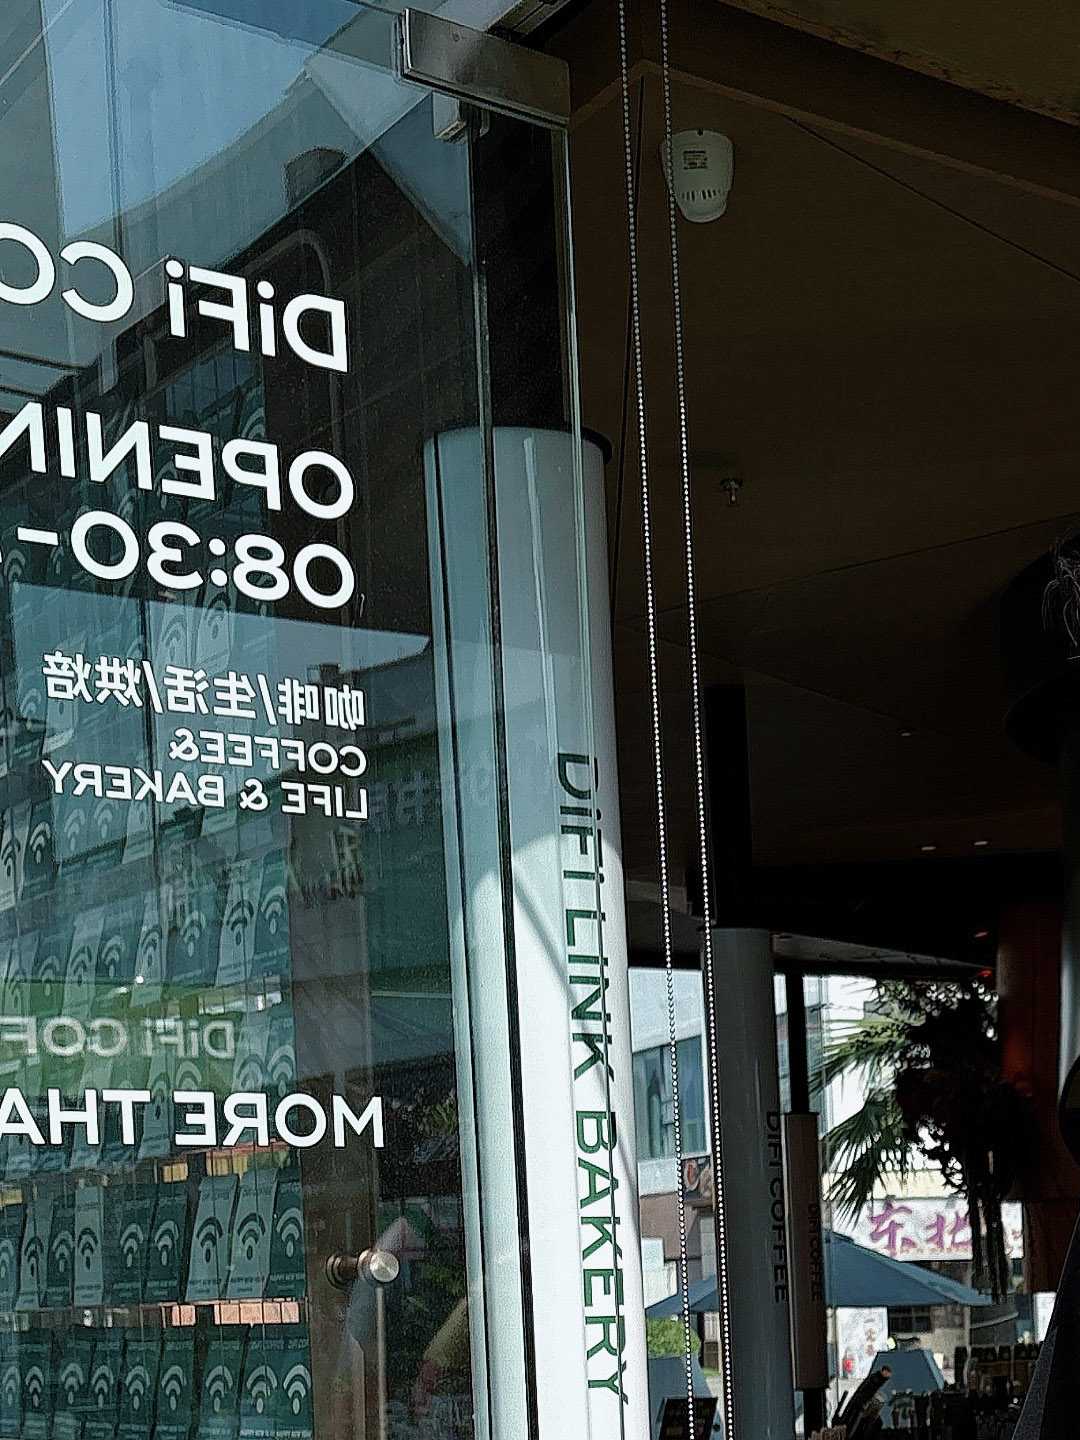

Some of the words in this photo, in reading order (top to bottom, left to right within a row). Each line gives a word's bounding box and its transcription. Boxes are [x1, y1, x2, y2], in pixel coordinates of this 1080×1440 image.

[557, 750, 604, 888] DiFi
[565, 907, 615, 1082] LINK
[574, 1109, 630, 1406] BAKERY
[770, 1176, 789, 1304] COFFEE
